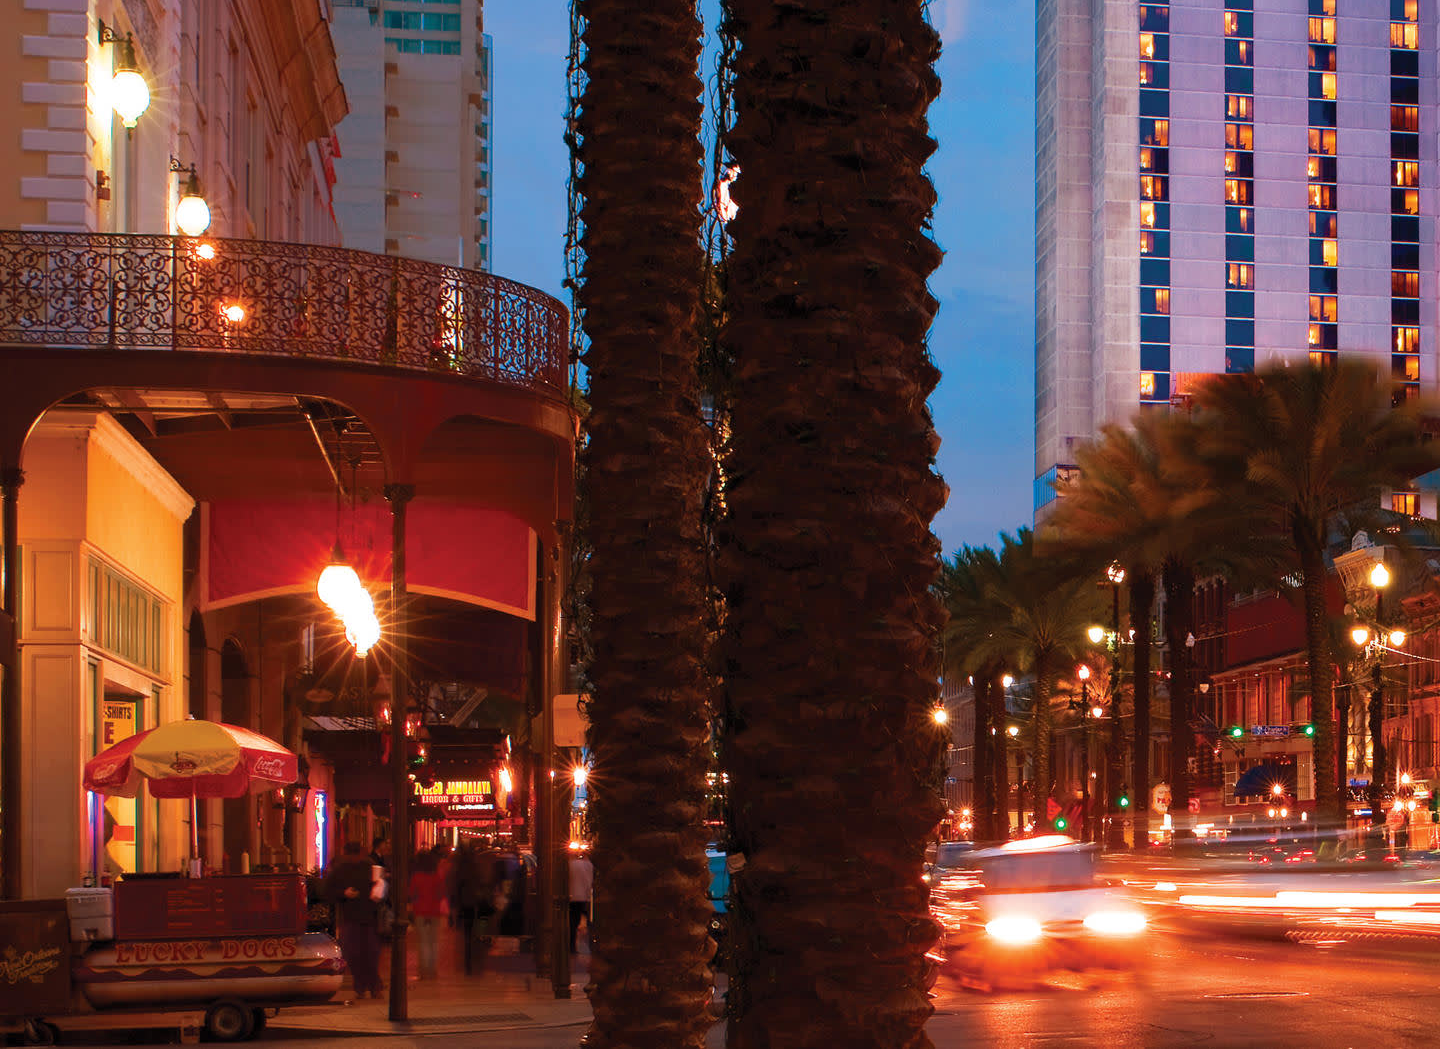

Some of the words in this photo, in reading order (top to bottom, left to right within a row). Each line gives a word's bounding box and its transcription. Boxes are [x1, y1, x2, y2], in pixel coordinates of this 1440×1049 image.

[103, 705, 132, 720] -SHIRTS
[446, 781, 491, 795] JAMBALAYA
[422, 795, 449, 803] LIQUOR
[463, 794, 484, 803] GIFTS
[115, 941, 209, 964] LUCKY
[221, 937, 297, 960] DOGS
